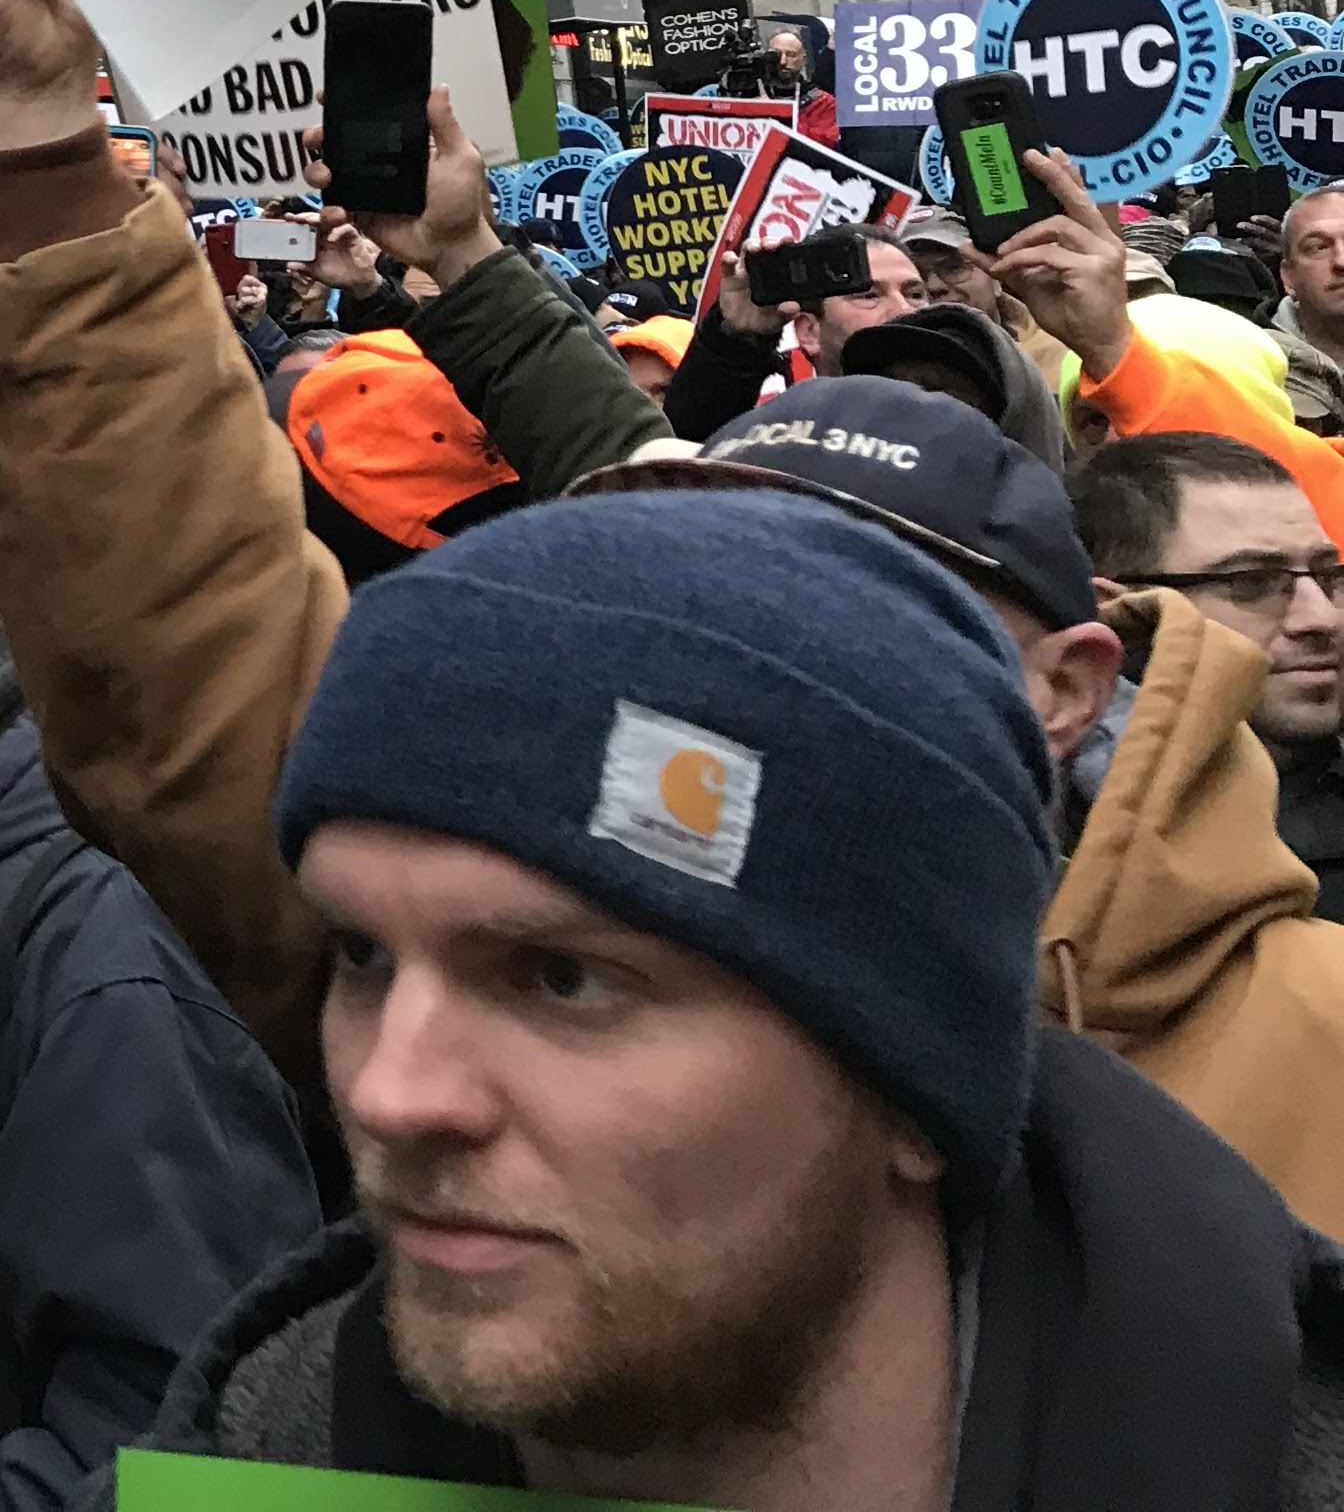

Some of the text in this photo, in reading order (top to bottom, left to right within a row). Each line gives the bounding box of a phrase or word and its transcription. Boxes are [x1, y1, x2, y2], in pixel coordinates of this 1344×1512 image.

[660, 7, 739, 28] COHEN'S
[662, 21, 740, 42] FASHION
[223, 57, 314, 116] BAD
[853, 16, 878, 113] LOCAL
[879, 12, 977, 94] 33
[1014, 23, 1178, 98] HTC
[1253, 92, 1281, 159] HOTEL
[643, 154, 713, 188] NYC
[975, 134, 1009, 206] #CountMeIn
